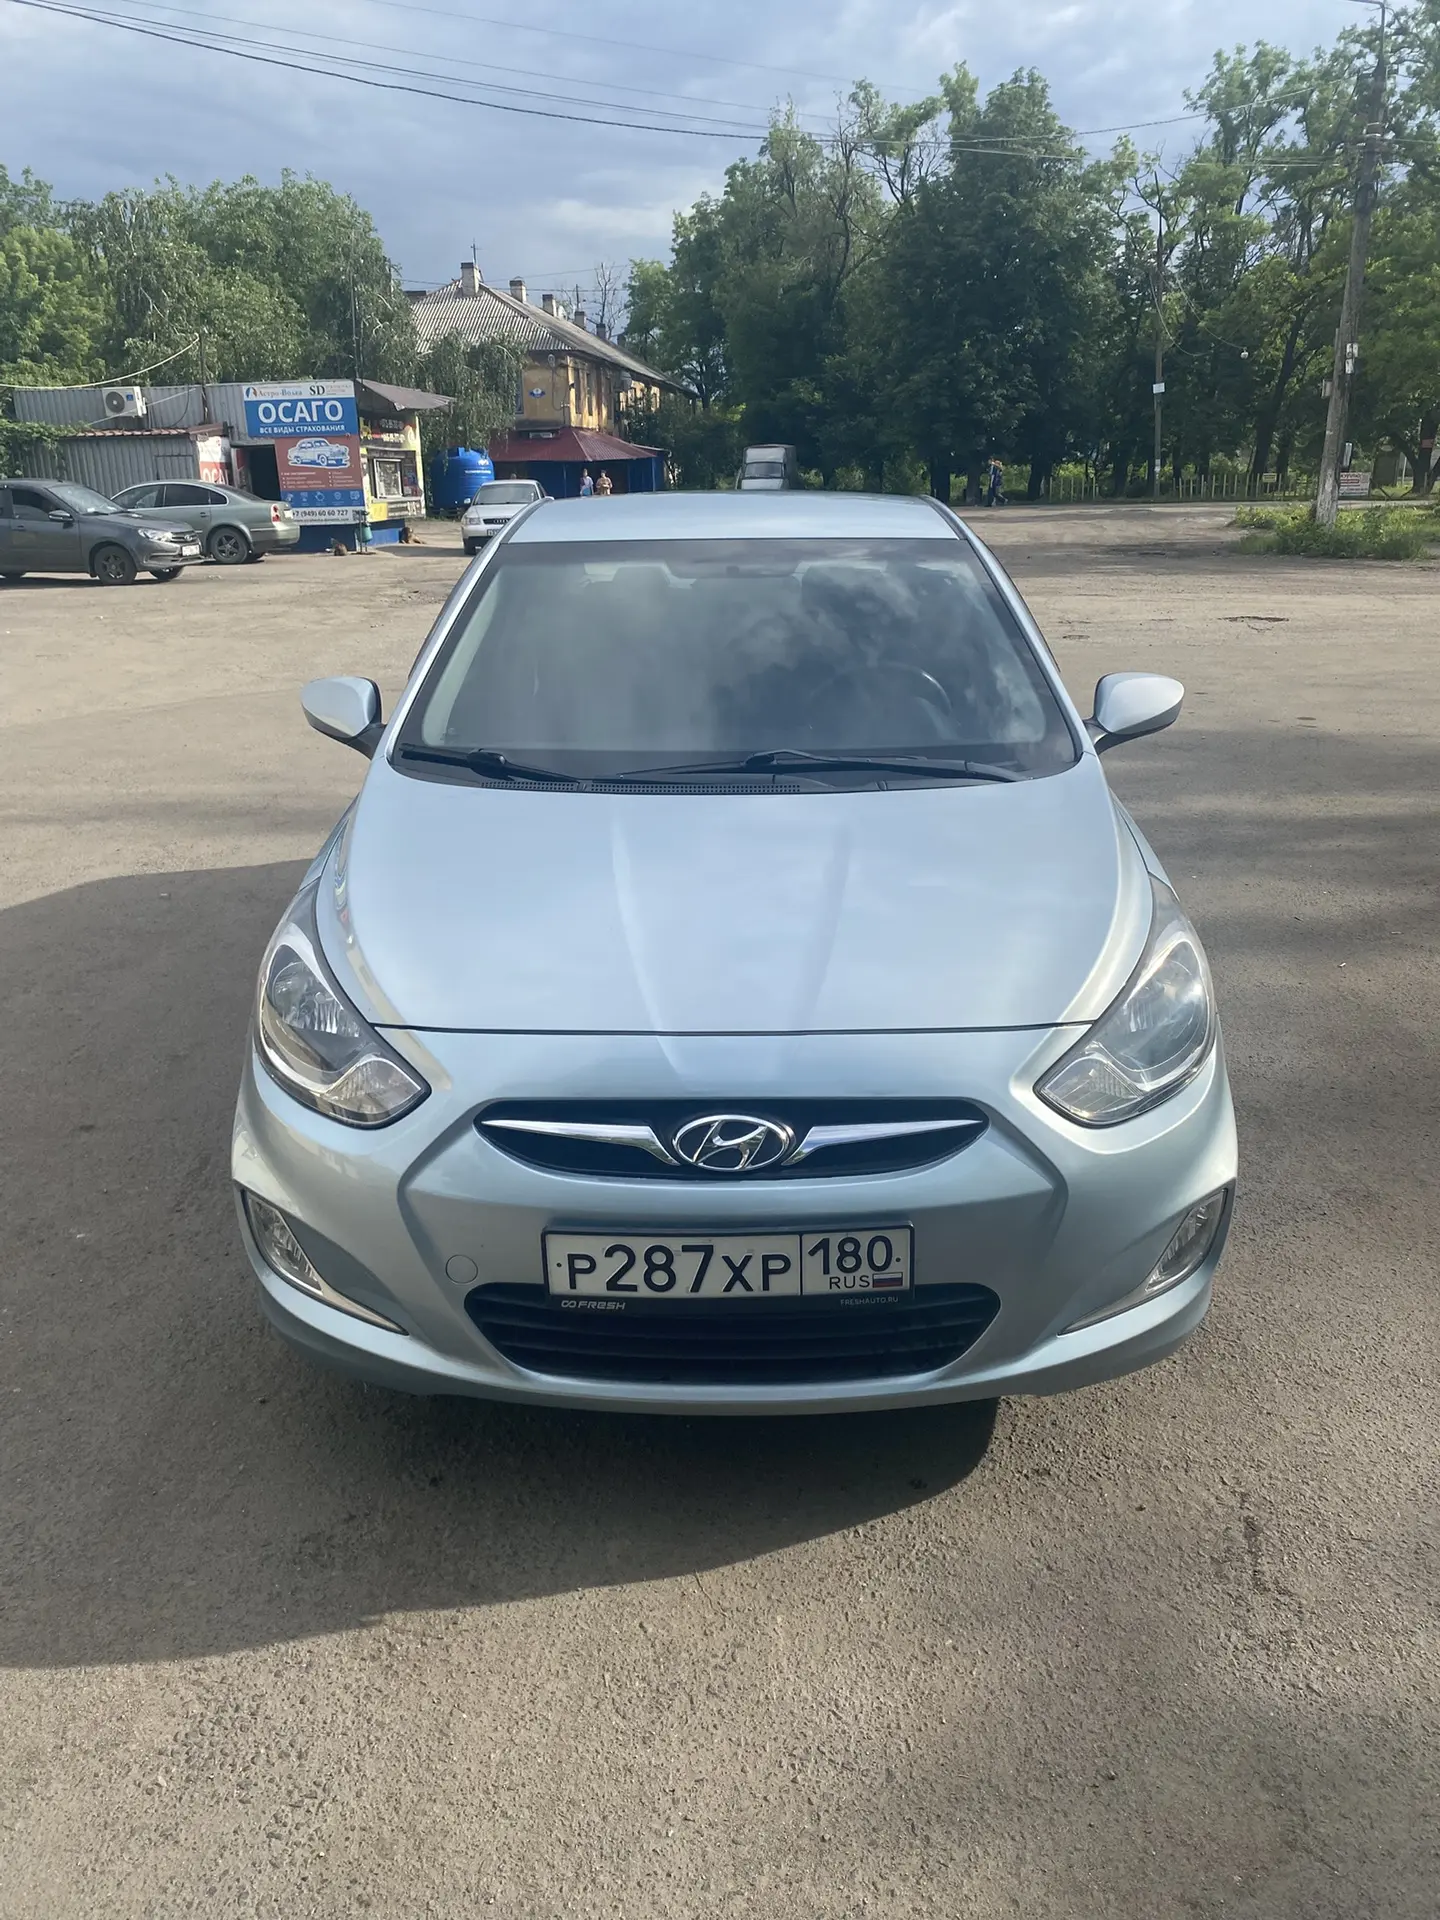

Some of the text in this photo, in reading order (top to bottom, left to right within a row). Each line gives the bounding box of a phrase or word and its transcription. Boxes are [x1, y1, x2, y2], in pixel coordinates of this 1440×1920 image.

[309, 385, 325, 396] SD
[258, 400, 343, 424] ОСАГО
[273, 426, 295, 435] ВИДЫ
[295, 424, 345, 433] СТРАХОВАНИЯ
[300, 510, 318, 518] (949)
[807, 1235, 893, 1275] 180
[829, 1275, 870, 1289] RUS
